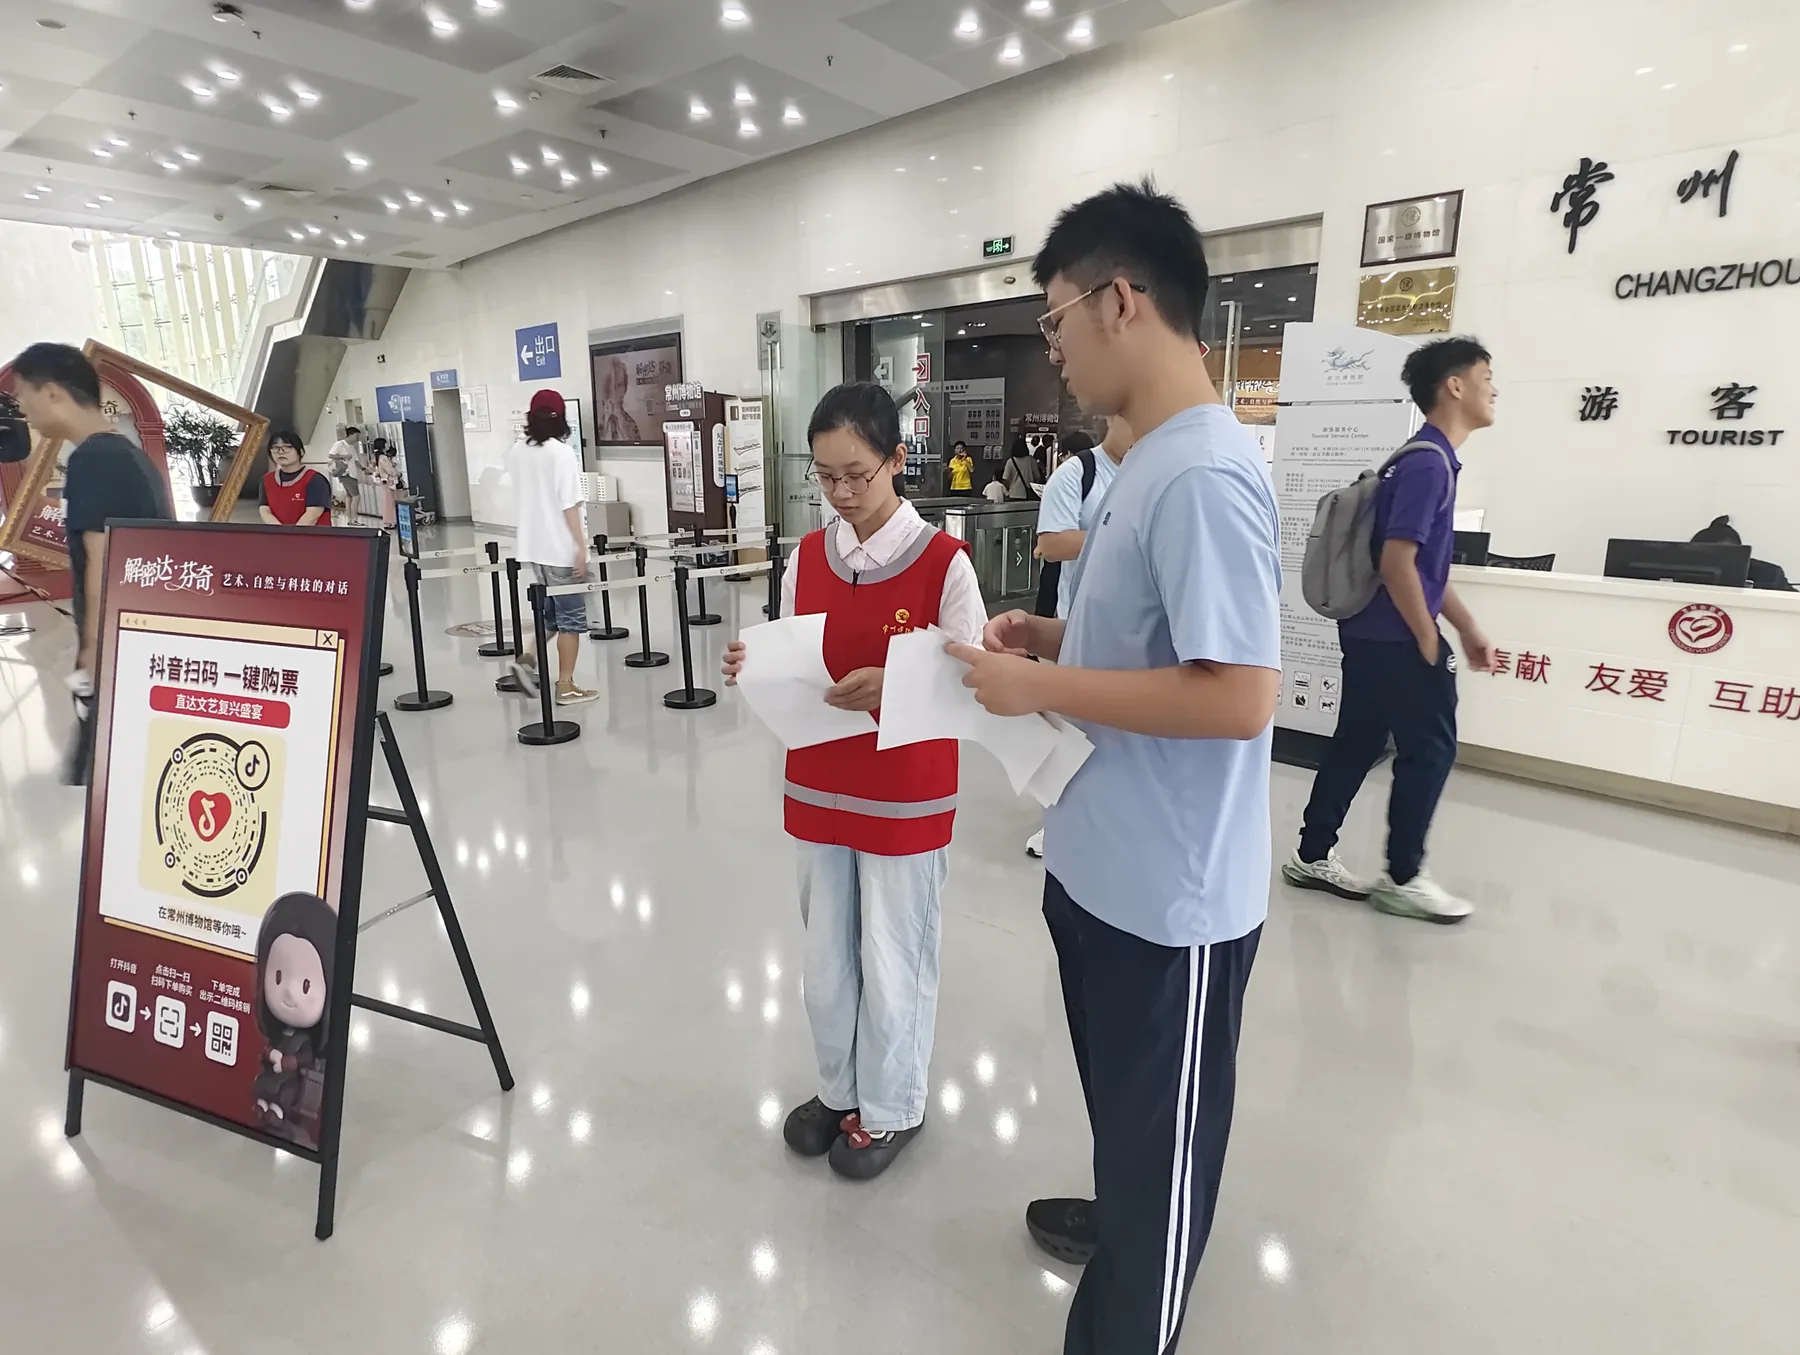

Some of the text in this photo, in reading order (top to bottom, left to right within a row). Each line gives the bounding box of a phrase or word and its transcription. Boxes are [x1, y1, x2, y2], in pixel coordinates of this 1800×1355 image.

[1615, 258, 1800, 299] CHANGZHOU
[534, 335, 555, 355] 出口
[912, 388, 931, 438] 入口
[1578, 382, 1758, 421] 游客
[1666, 430, 1785, 446] TOURIST
[223, 573, 349, 595] 艺术、自然与科技的对话
[149, 654, 300, 696] 抖音扫码 一键购票
[1584, 662, 1669, 703] 友爱
[1709, 680, 1800, 721] 互助
[175, 694, 263, 721] 直达文艺复兴盛宴
[109, 958, 138, 975] 打开抖音
[155, 964, 191, 983] 点击扫一扫
[151, 975, 193, 997] 扫码下单购买
[211, 980, 241, 998] 下单完成
[199, 989, 251, 1015] 出示二维码核销
